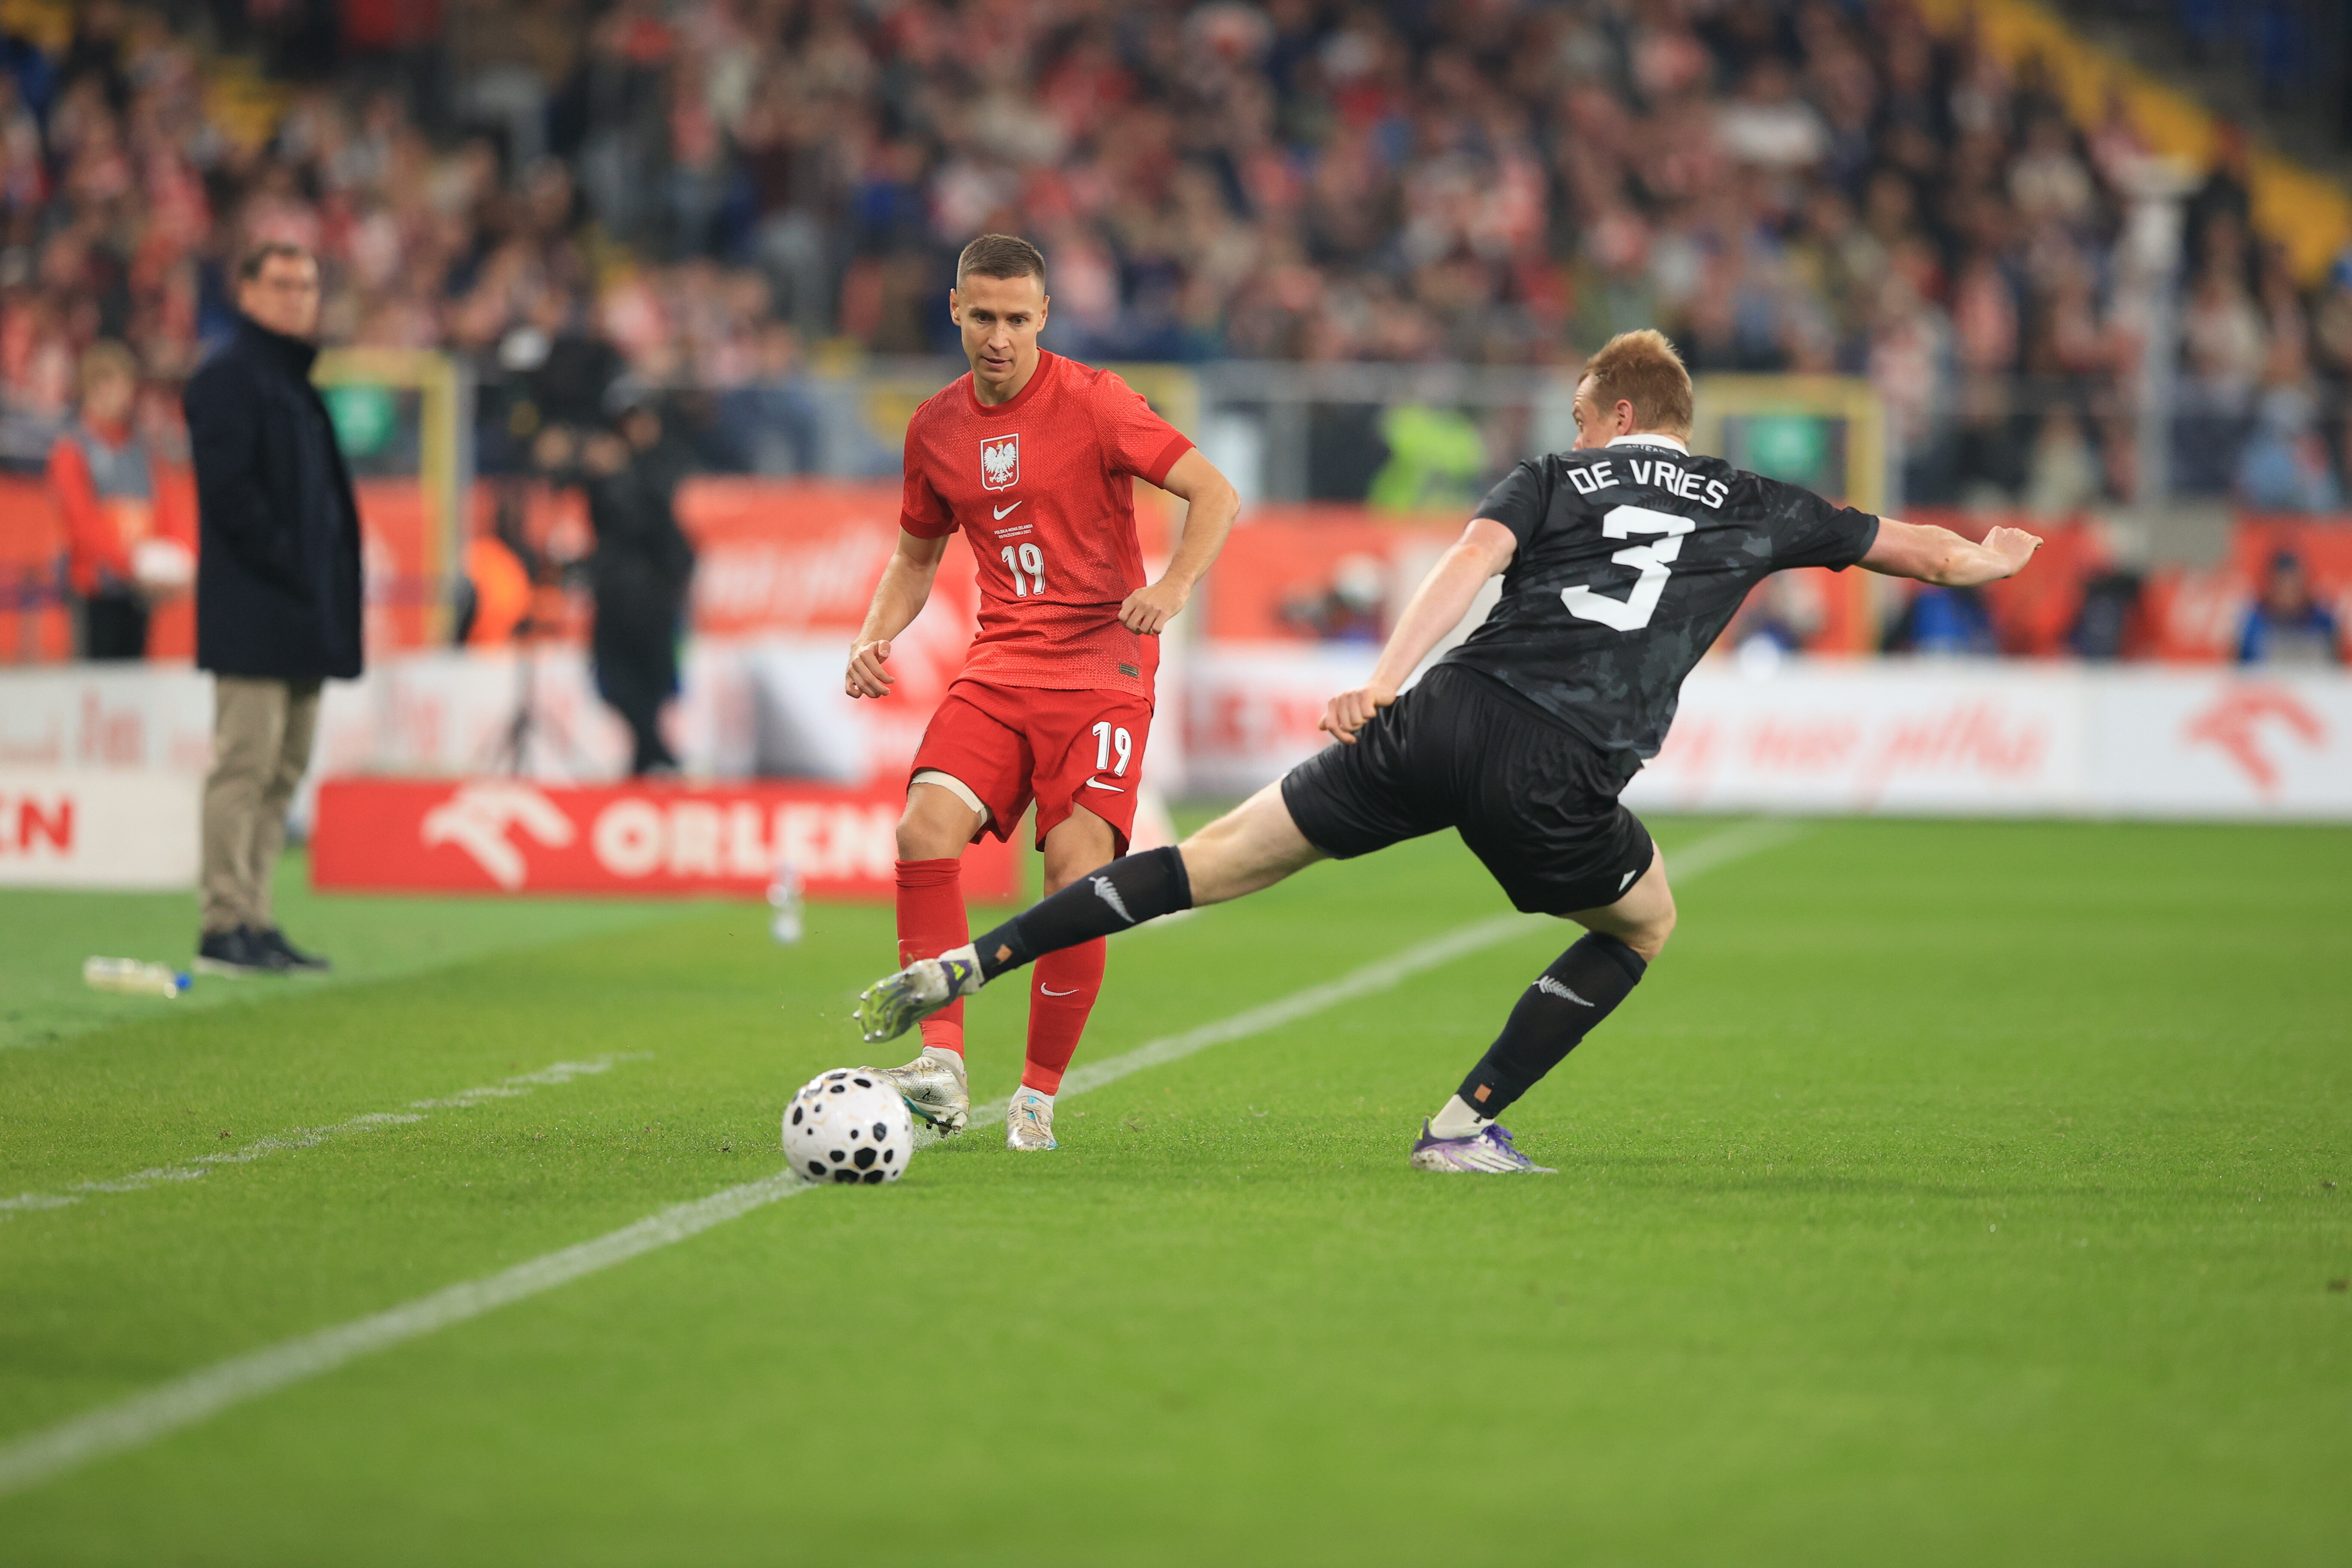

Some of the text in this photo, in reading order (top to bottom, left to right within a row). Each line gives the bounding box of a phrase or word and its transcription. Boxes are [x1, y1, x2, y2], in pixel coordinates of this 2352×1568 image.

[1566, 459, 1729, 509] DE VRIES
[1001, 543, 1045, 597] 19
[1560, 505, 1696, 632] 3
[1092, 721, 1132, 777] 19
[593, 798, 896, 879] ORLEN
